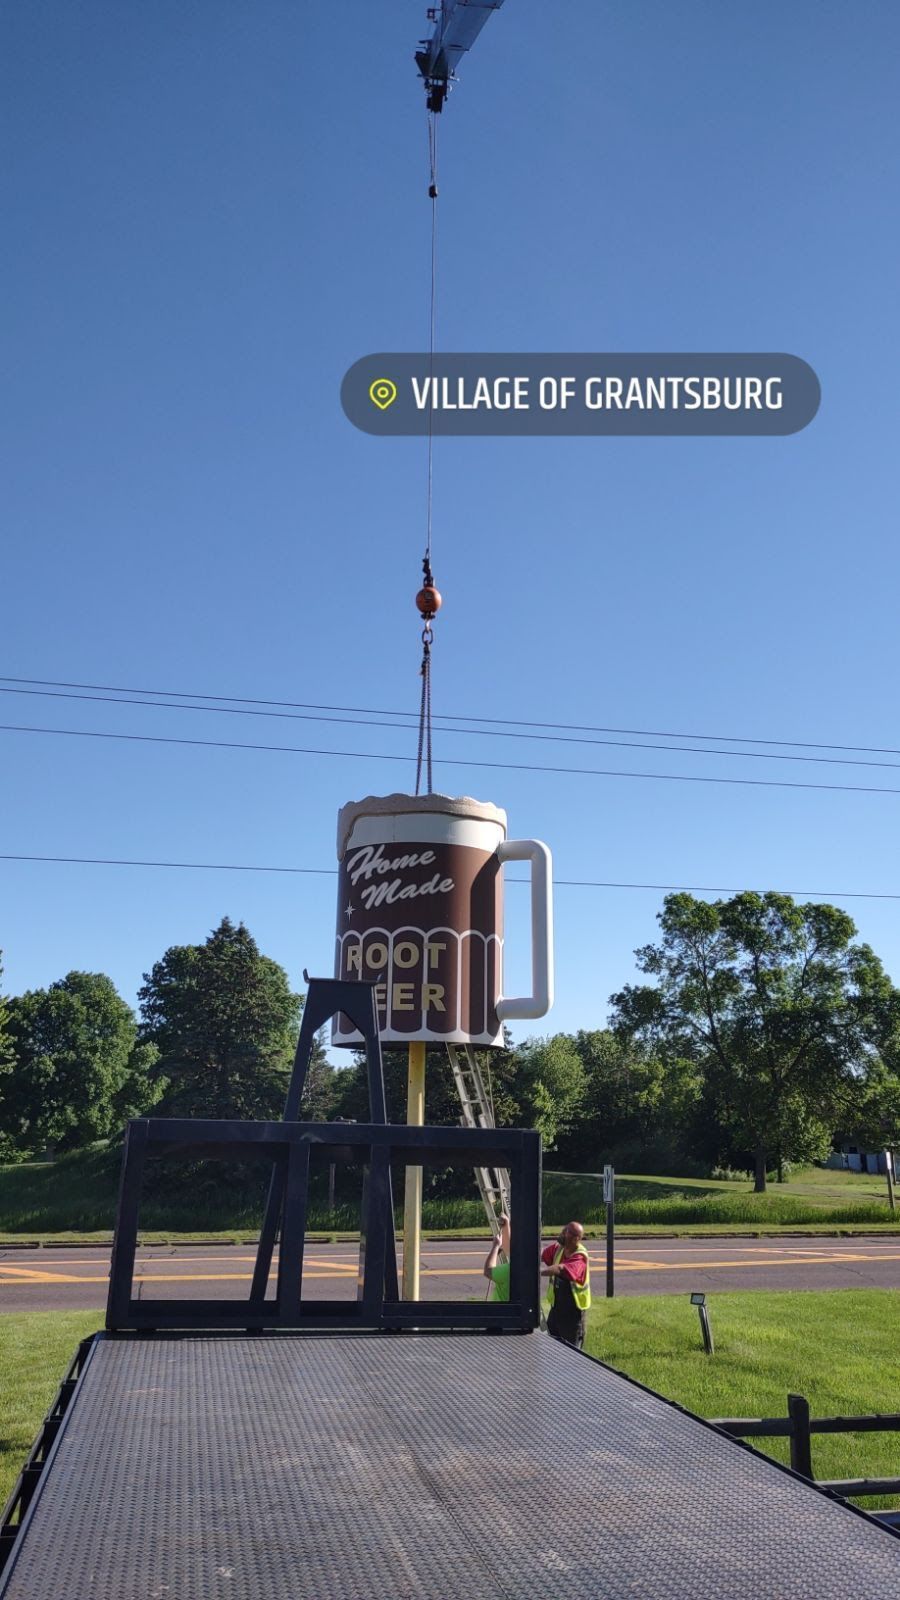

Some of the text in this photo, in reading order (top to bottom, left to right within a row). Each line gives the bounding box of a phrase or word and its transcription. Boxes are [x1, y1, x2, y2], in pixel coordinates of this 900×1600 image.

[346, 844, 437, 887] Home
[360, 873, 455, 910] Made
[346, 941, 447, 972] ROOT
[374, 983, 447, 1012] EER
